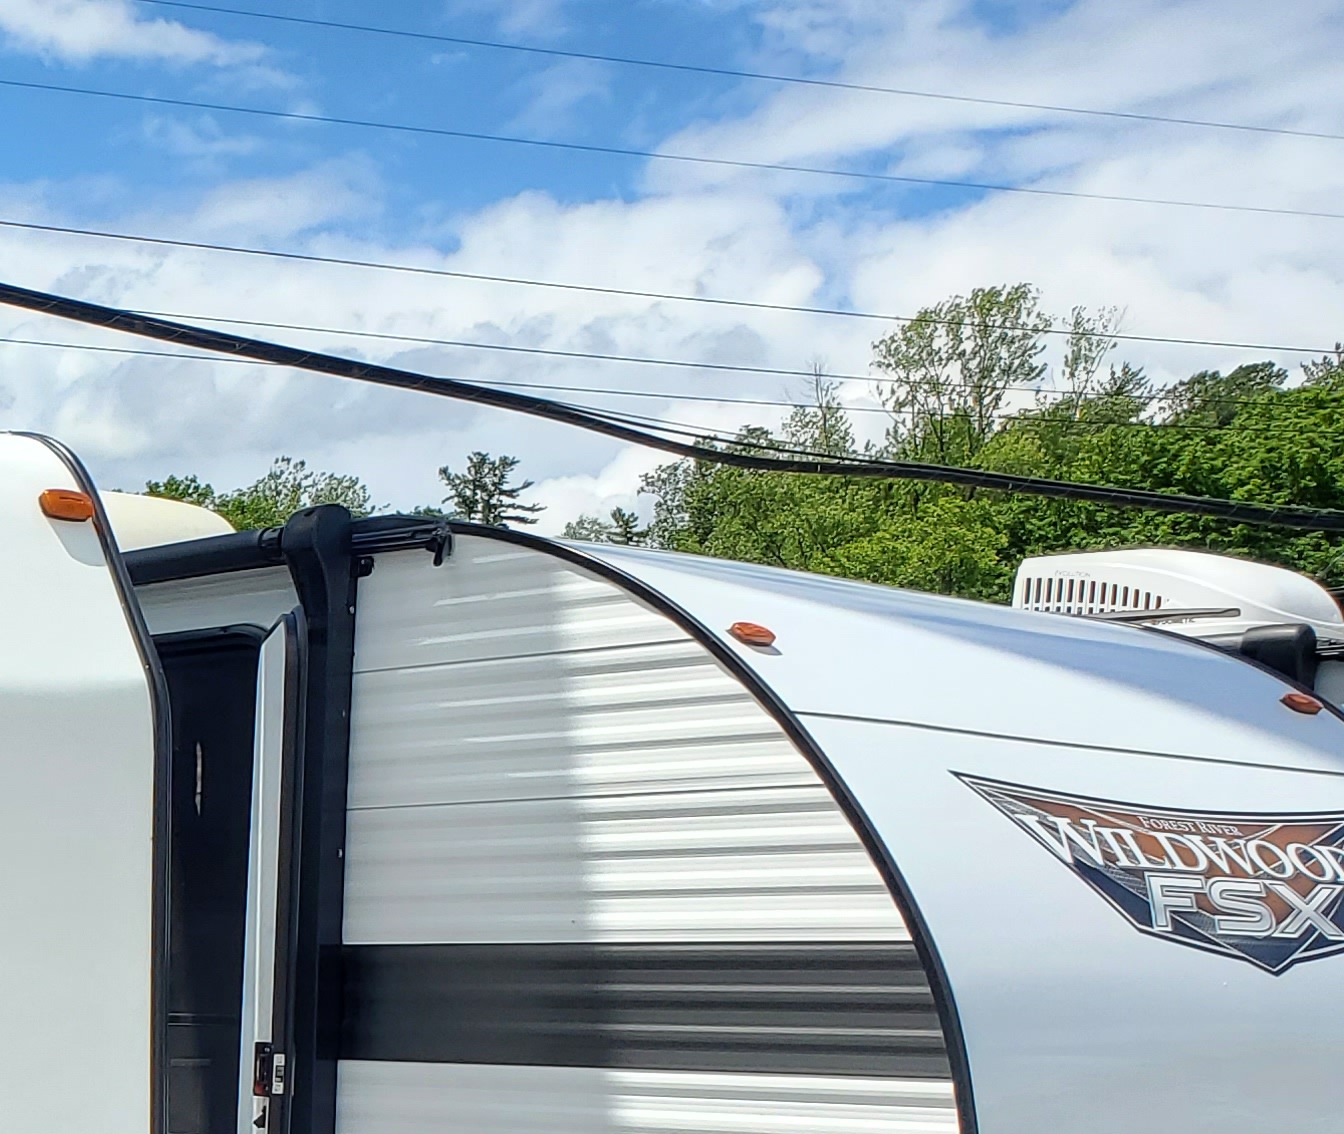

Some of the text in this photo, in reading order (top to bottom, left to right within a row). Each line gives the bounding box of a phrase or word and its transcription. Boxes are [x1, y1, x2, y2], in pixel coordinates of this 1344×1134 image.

[1137, 815, 1244, 837] FOREST RIVER
[1144, 871, 1344, 940] FSX
